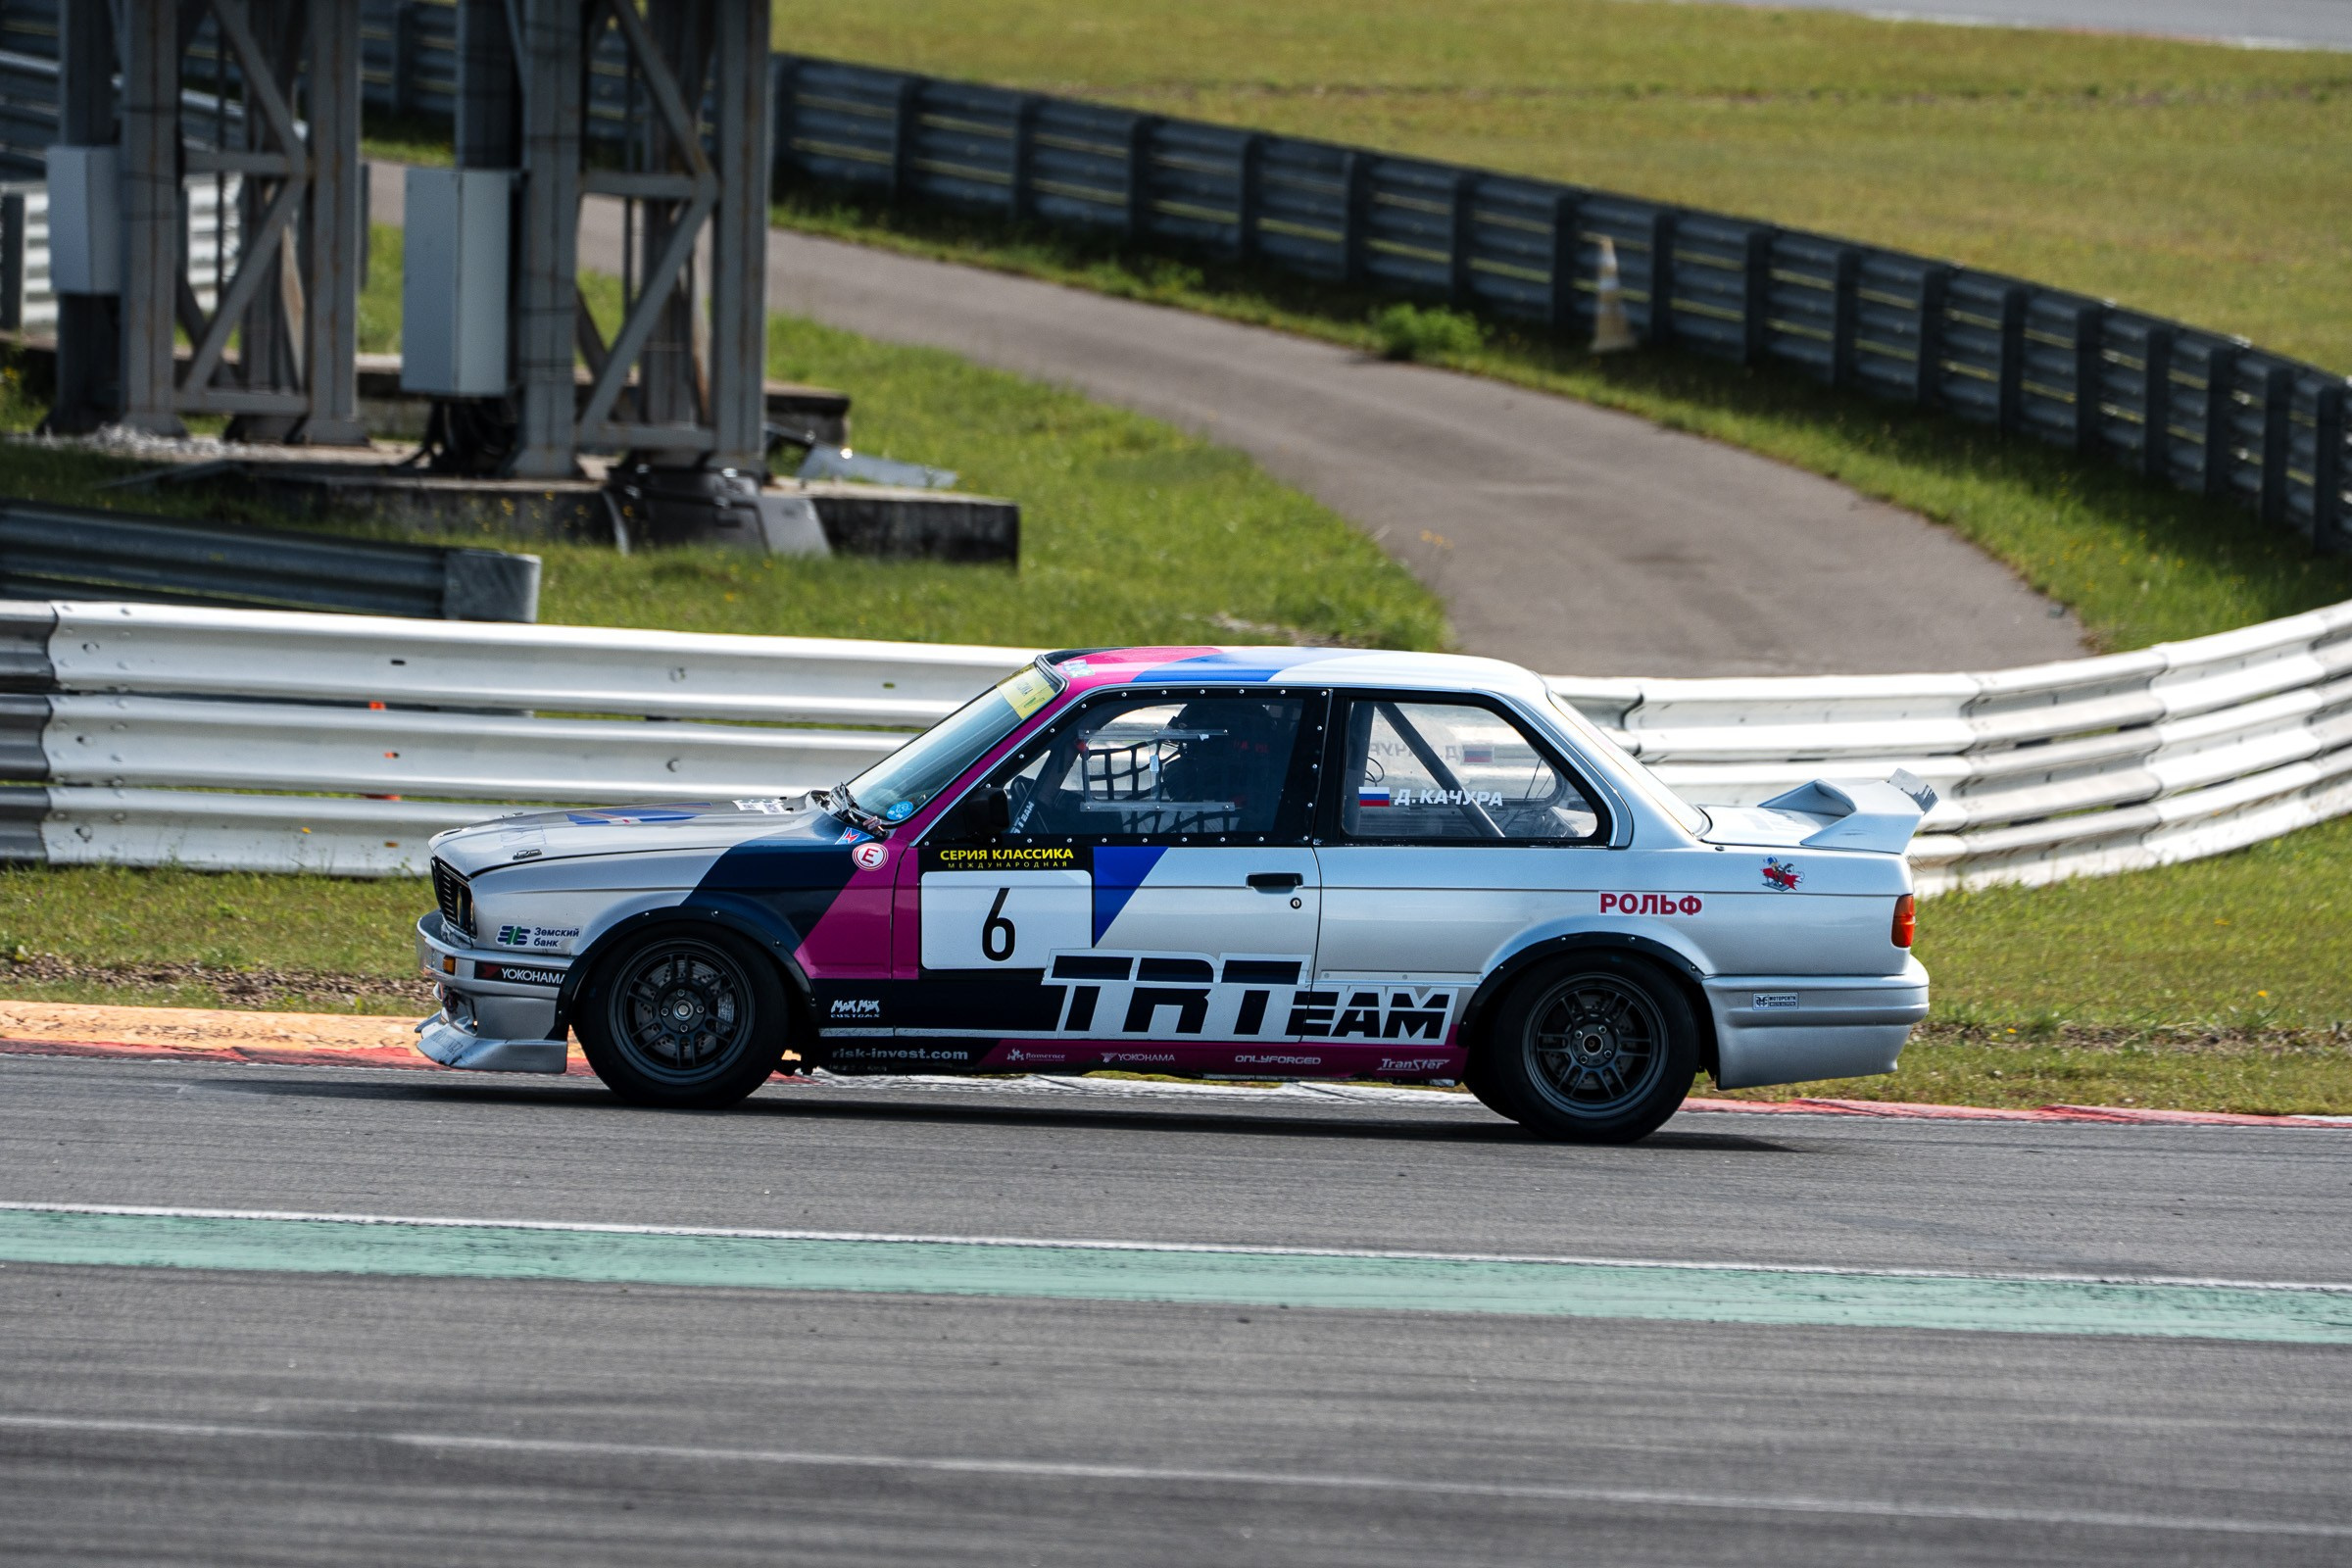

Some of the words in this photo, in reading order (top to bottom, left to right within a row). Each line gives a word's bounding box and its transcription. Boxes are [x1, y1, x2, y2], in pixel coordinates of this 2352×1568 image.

[861, 848, 878, 864] E
[940, 850, 988, 860] СЕРИЯ
[992, 849, 1074, 859] КЛАССИКА
[1599, 893, 1702, 915] РОЛЬФ
[982, 887, 1015, 961] 6
[534, 927, 580, 937] Земский
[533, 938, 559, 947] банк
[832, 1048, 968, 1060] risk-invest.com
